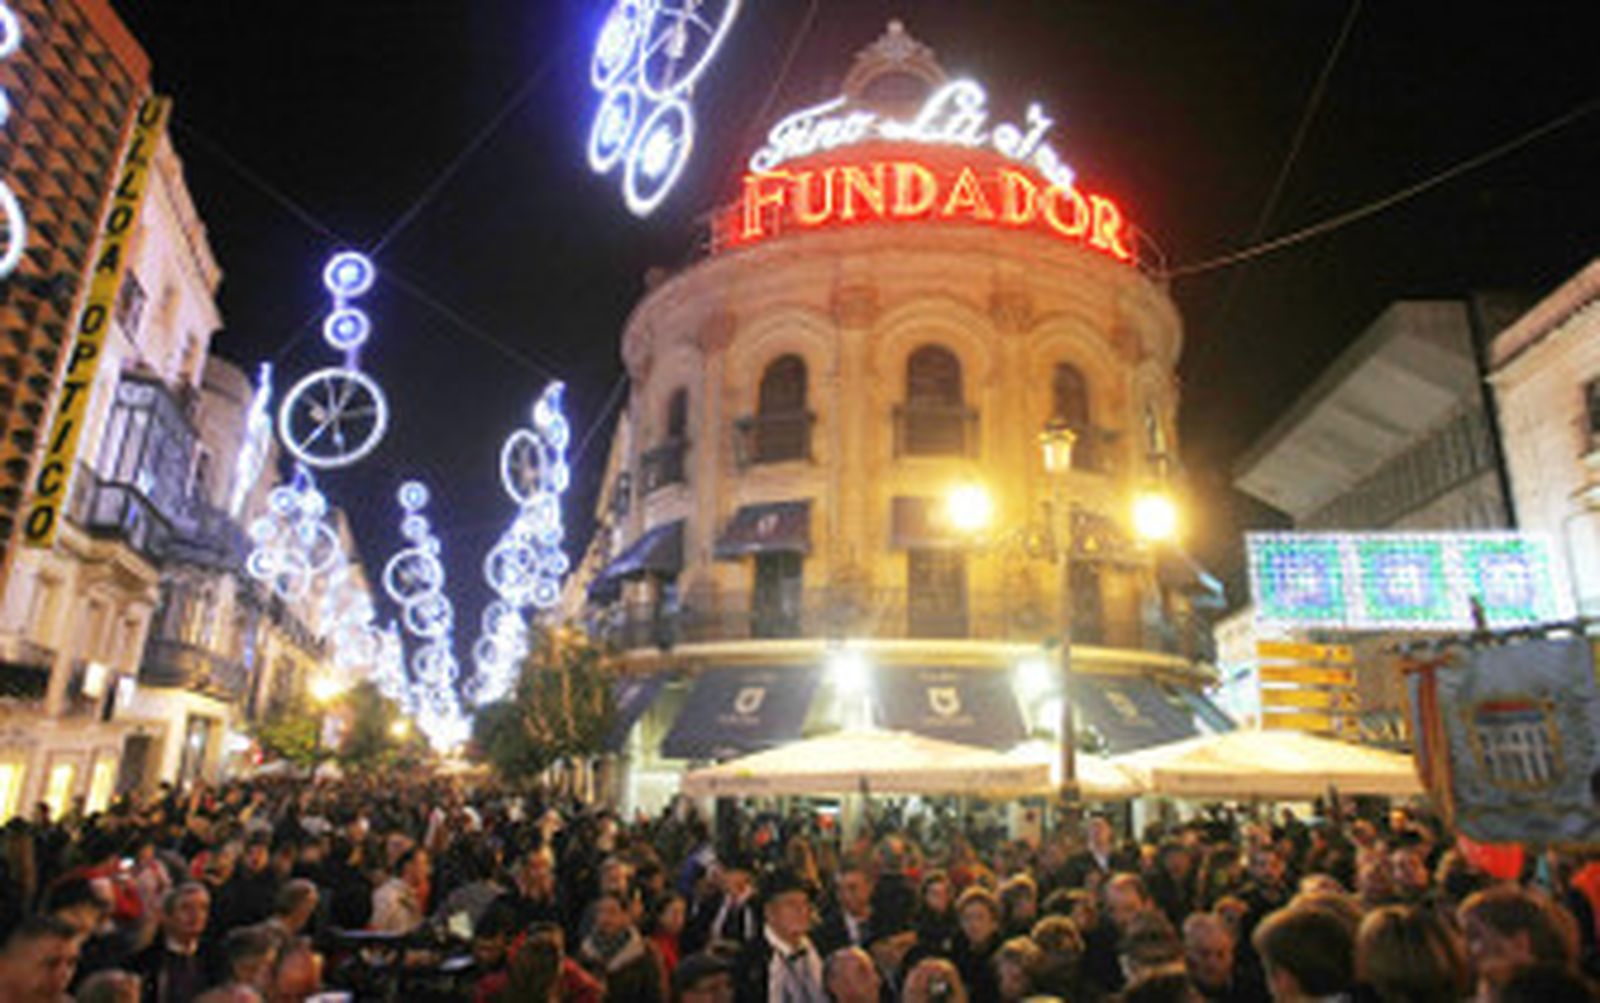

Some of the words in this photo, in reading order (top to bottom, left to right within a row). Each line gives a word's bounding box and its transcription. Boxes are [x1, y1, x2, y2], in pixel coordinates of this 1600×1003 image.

[748, 94, 878, 173] Fino
[741, 161, 1134, 261] FUNDADOR
[26, 304, 106, 540] OPTICO
